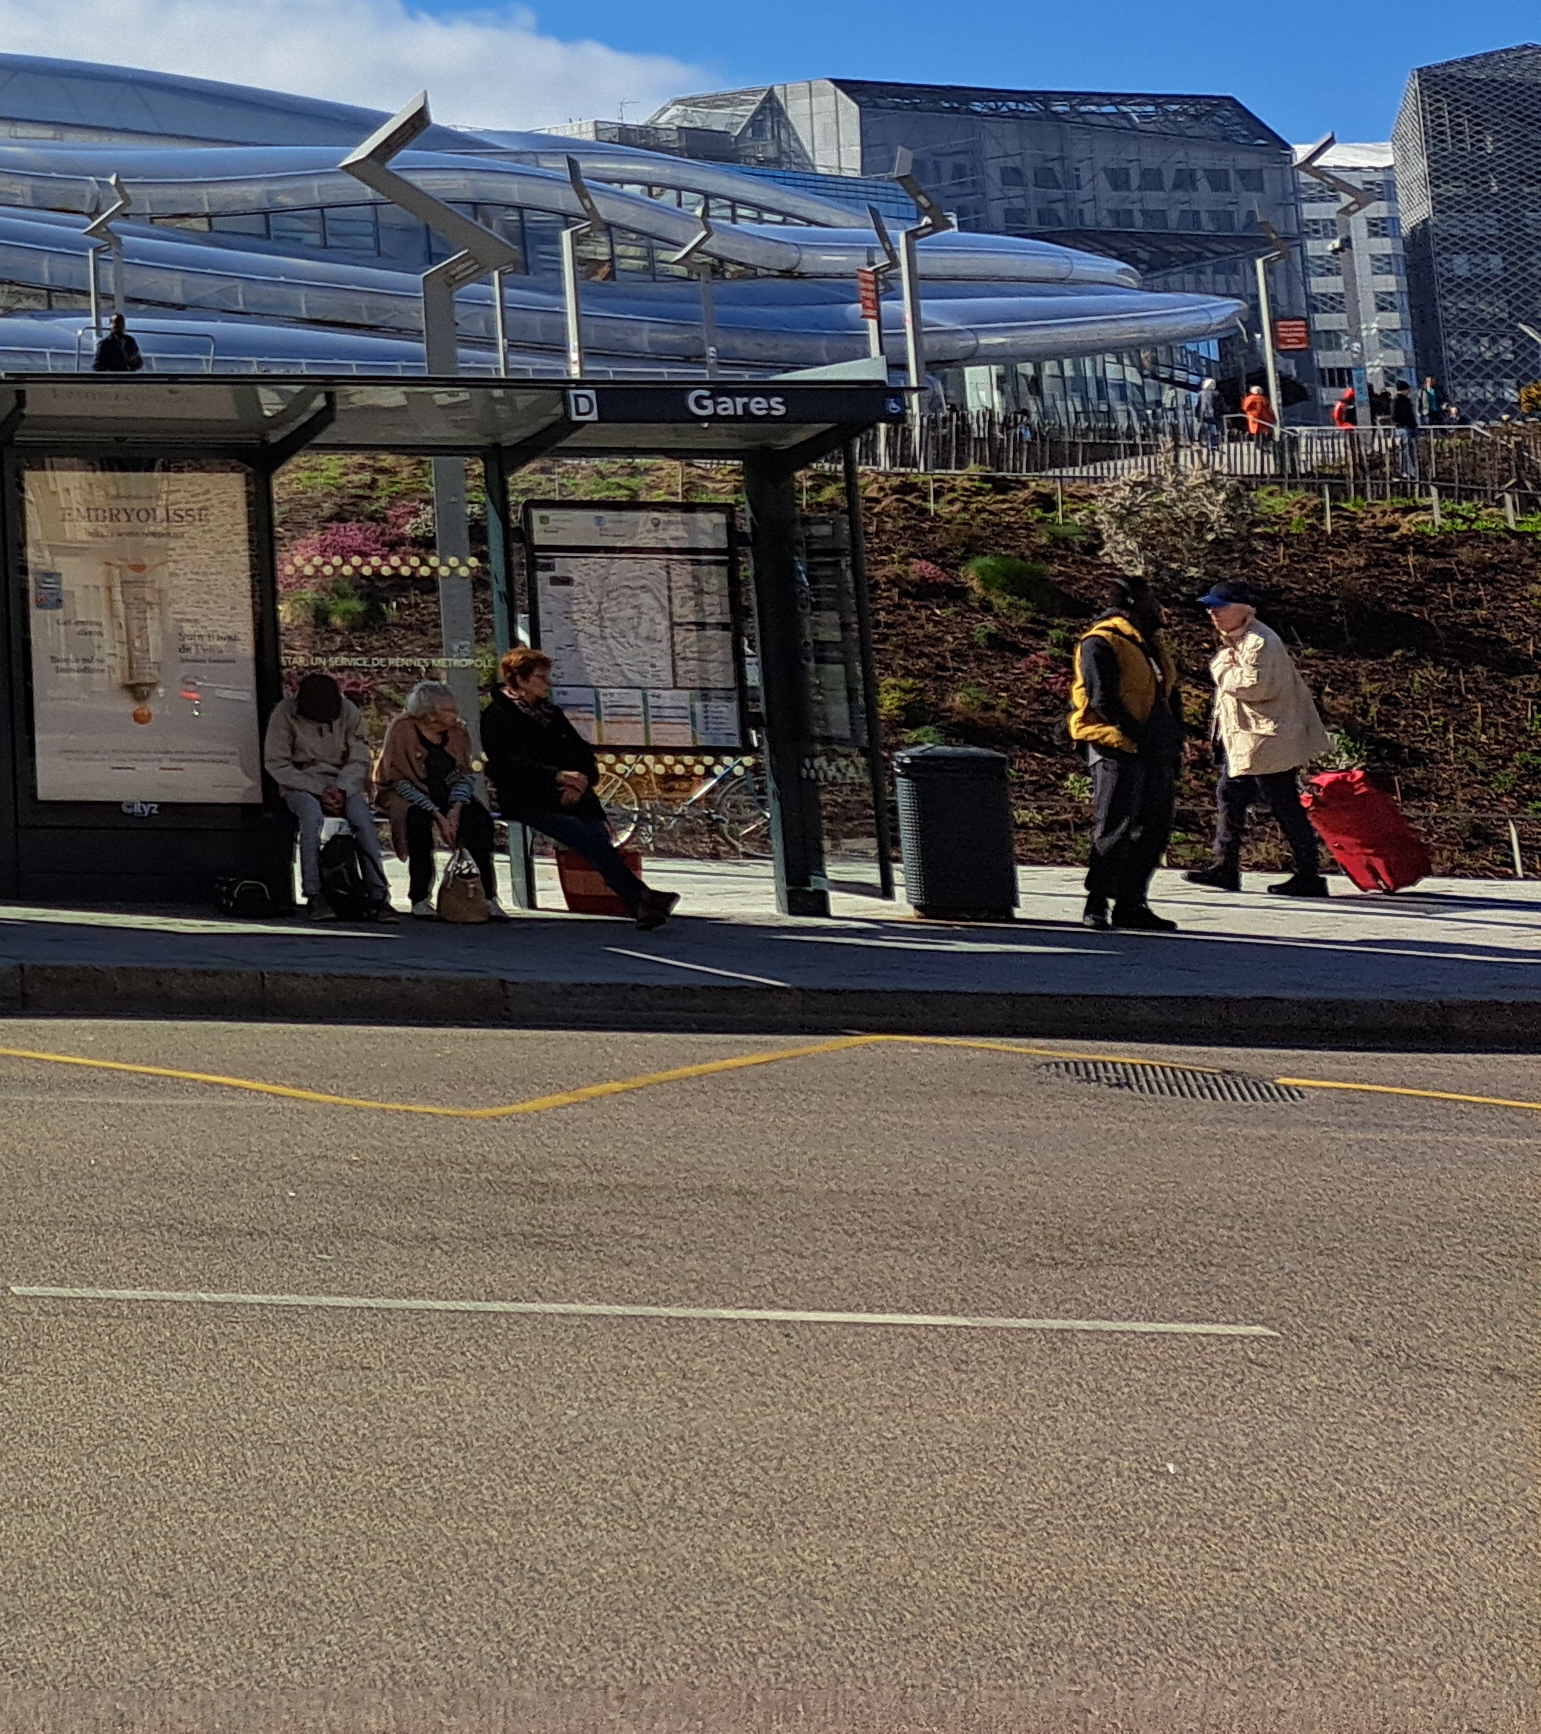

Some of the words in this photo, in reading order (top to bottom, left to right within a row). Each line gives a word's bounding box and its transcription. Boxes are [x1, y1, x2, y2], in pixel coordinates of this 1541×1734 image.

[573, 392, 595, 416] D
[687, 388, 787, 416] Gares
[59, 507, 211, 524] EMBRYOLISSE
[310, 657, 327, 666] UN
[328, 657, 371, 667] SERVICE
[372, 657, 388, 667] DE
[388, 657, 430, 668] RENNES
